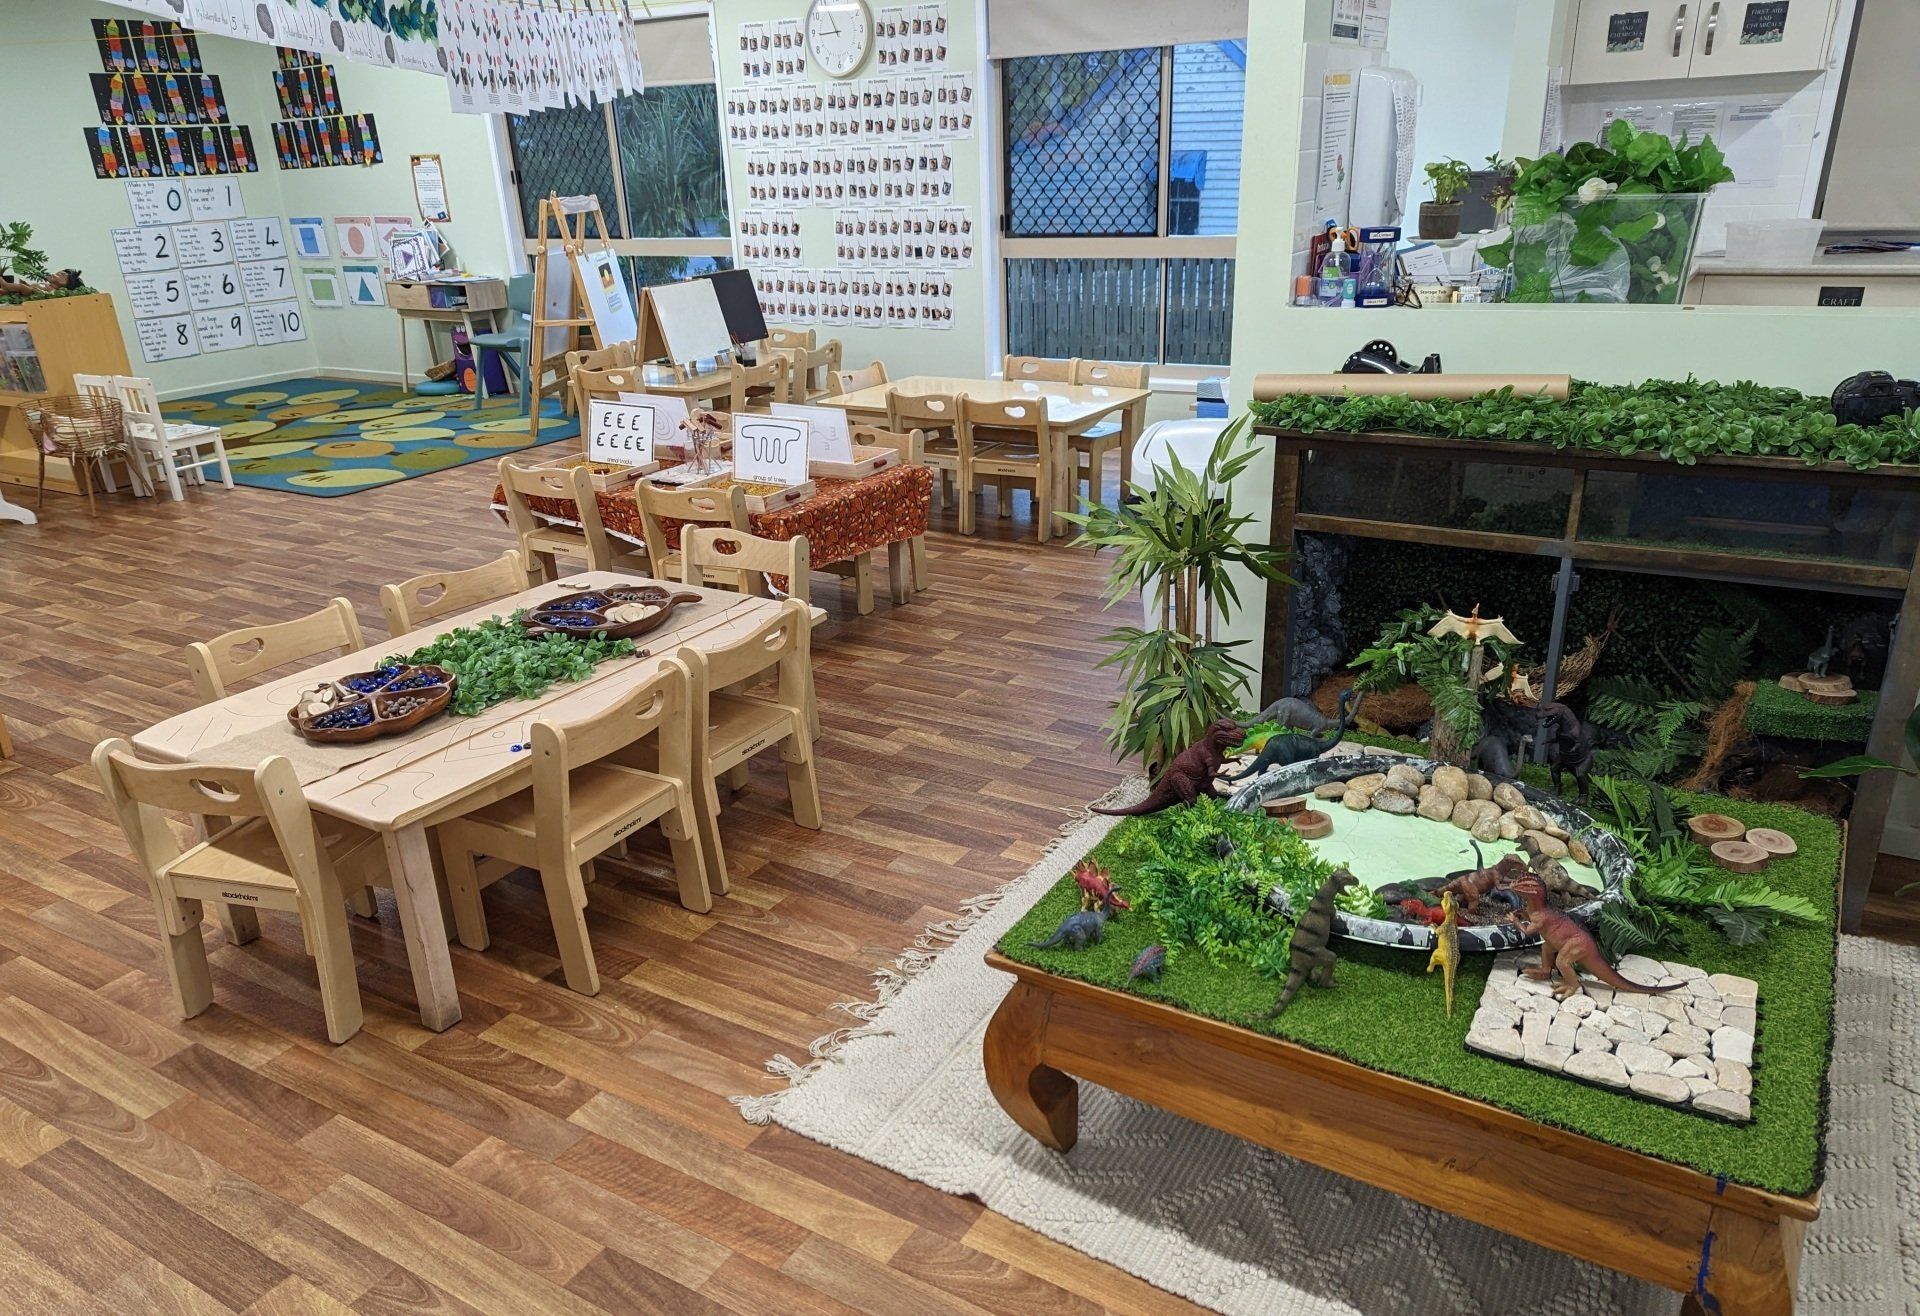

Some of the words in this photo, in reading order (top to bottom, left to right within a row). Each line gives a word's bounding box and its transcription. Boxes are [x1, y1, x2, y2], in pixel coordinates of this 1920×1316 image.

[232, 16, 237, 31] 5
[167, 189, 182, 211] 0
[227, 185, 231, 207] 1
[154, 235, 170, 258] 2
[211, 231, 224, 252] 3
[265, 227, 279, 246] 4
[222, 274, 234, 295] 6
[273, 268, 284, 288] 7
[166, 280, 179, 302] 5
[1822, 298, 1859, 306] CRAFT
[231, 316, 242, 337] 9
[280, 312, 300, 332] 10
[176, 324, 188, 345] 8
[613, 817, 642, 837] stockholm
[222, 891, 258, 901] stockholm
